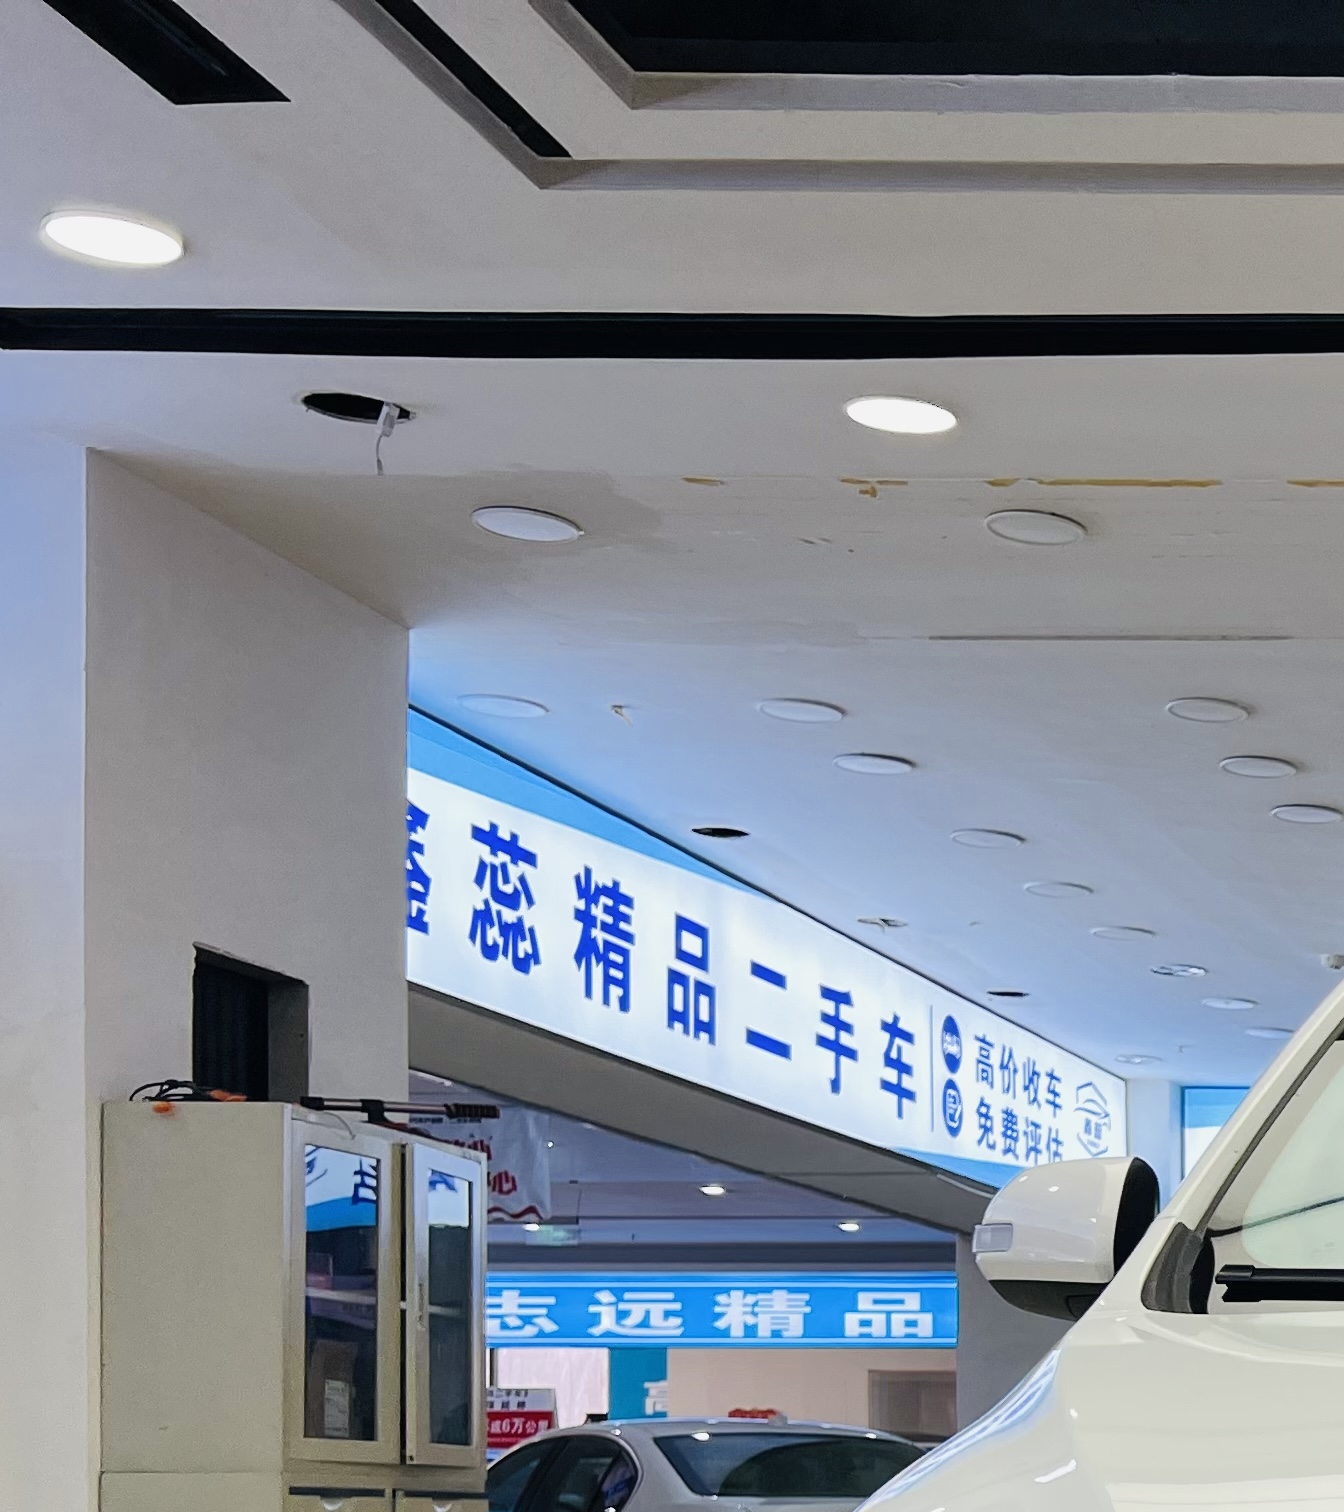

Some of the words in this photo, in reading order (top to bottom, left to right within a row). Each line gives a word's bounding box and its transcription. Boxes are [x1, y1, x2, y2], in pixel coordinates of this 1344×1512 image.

[974, 1034, 1063, 1118] 高价收车
[976, 1097, 1064, 1165] 免费评估
[486, 1289, 934, 1338] 志远精品
